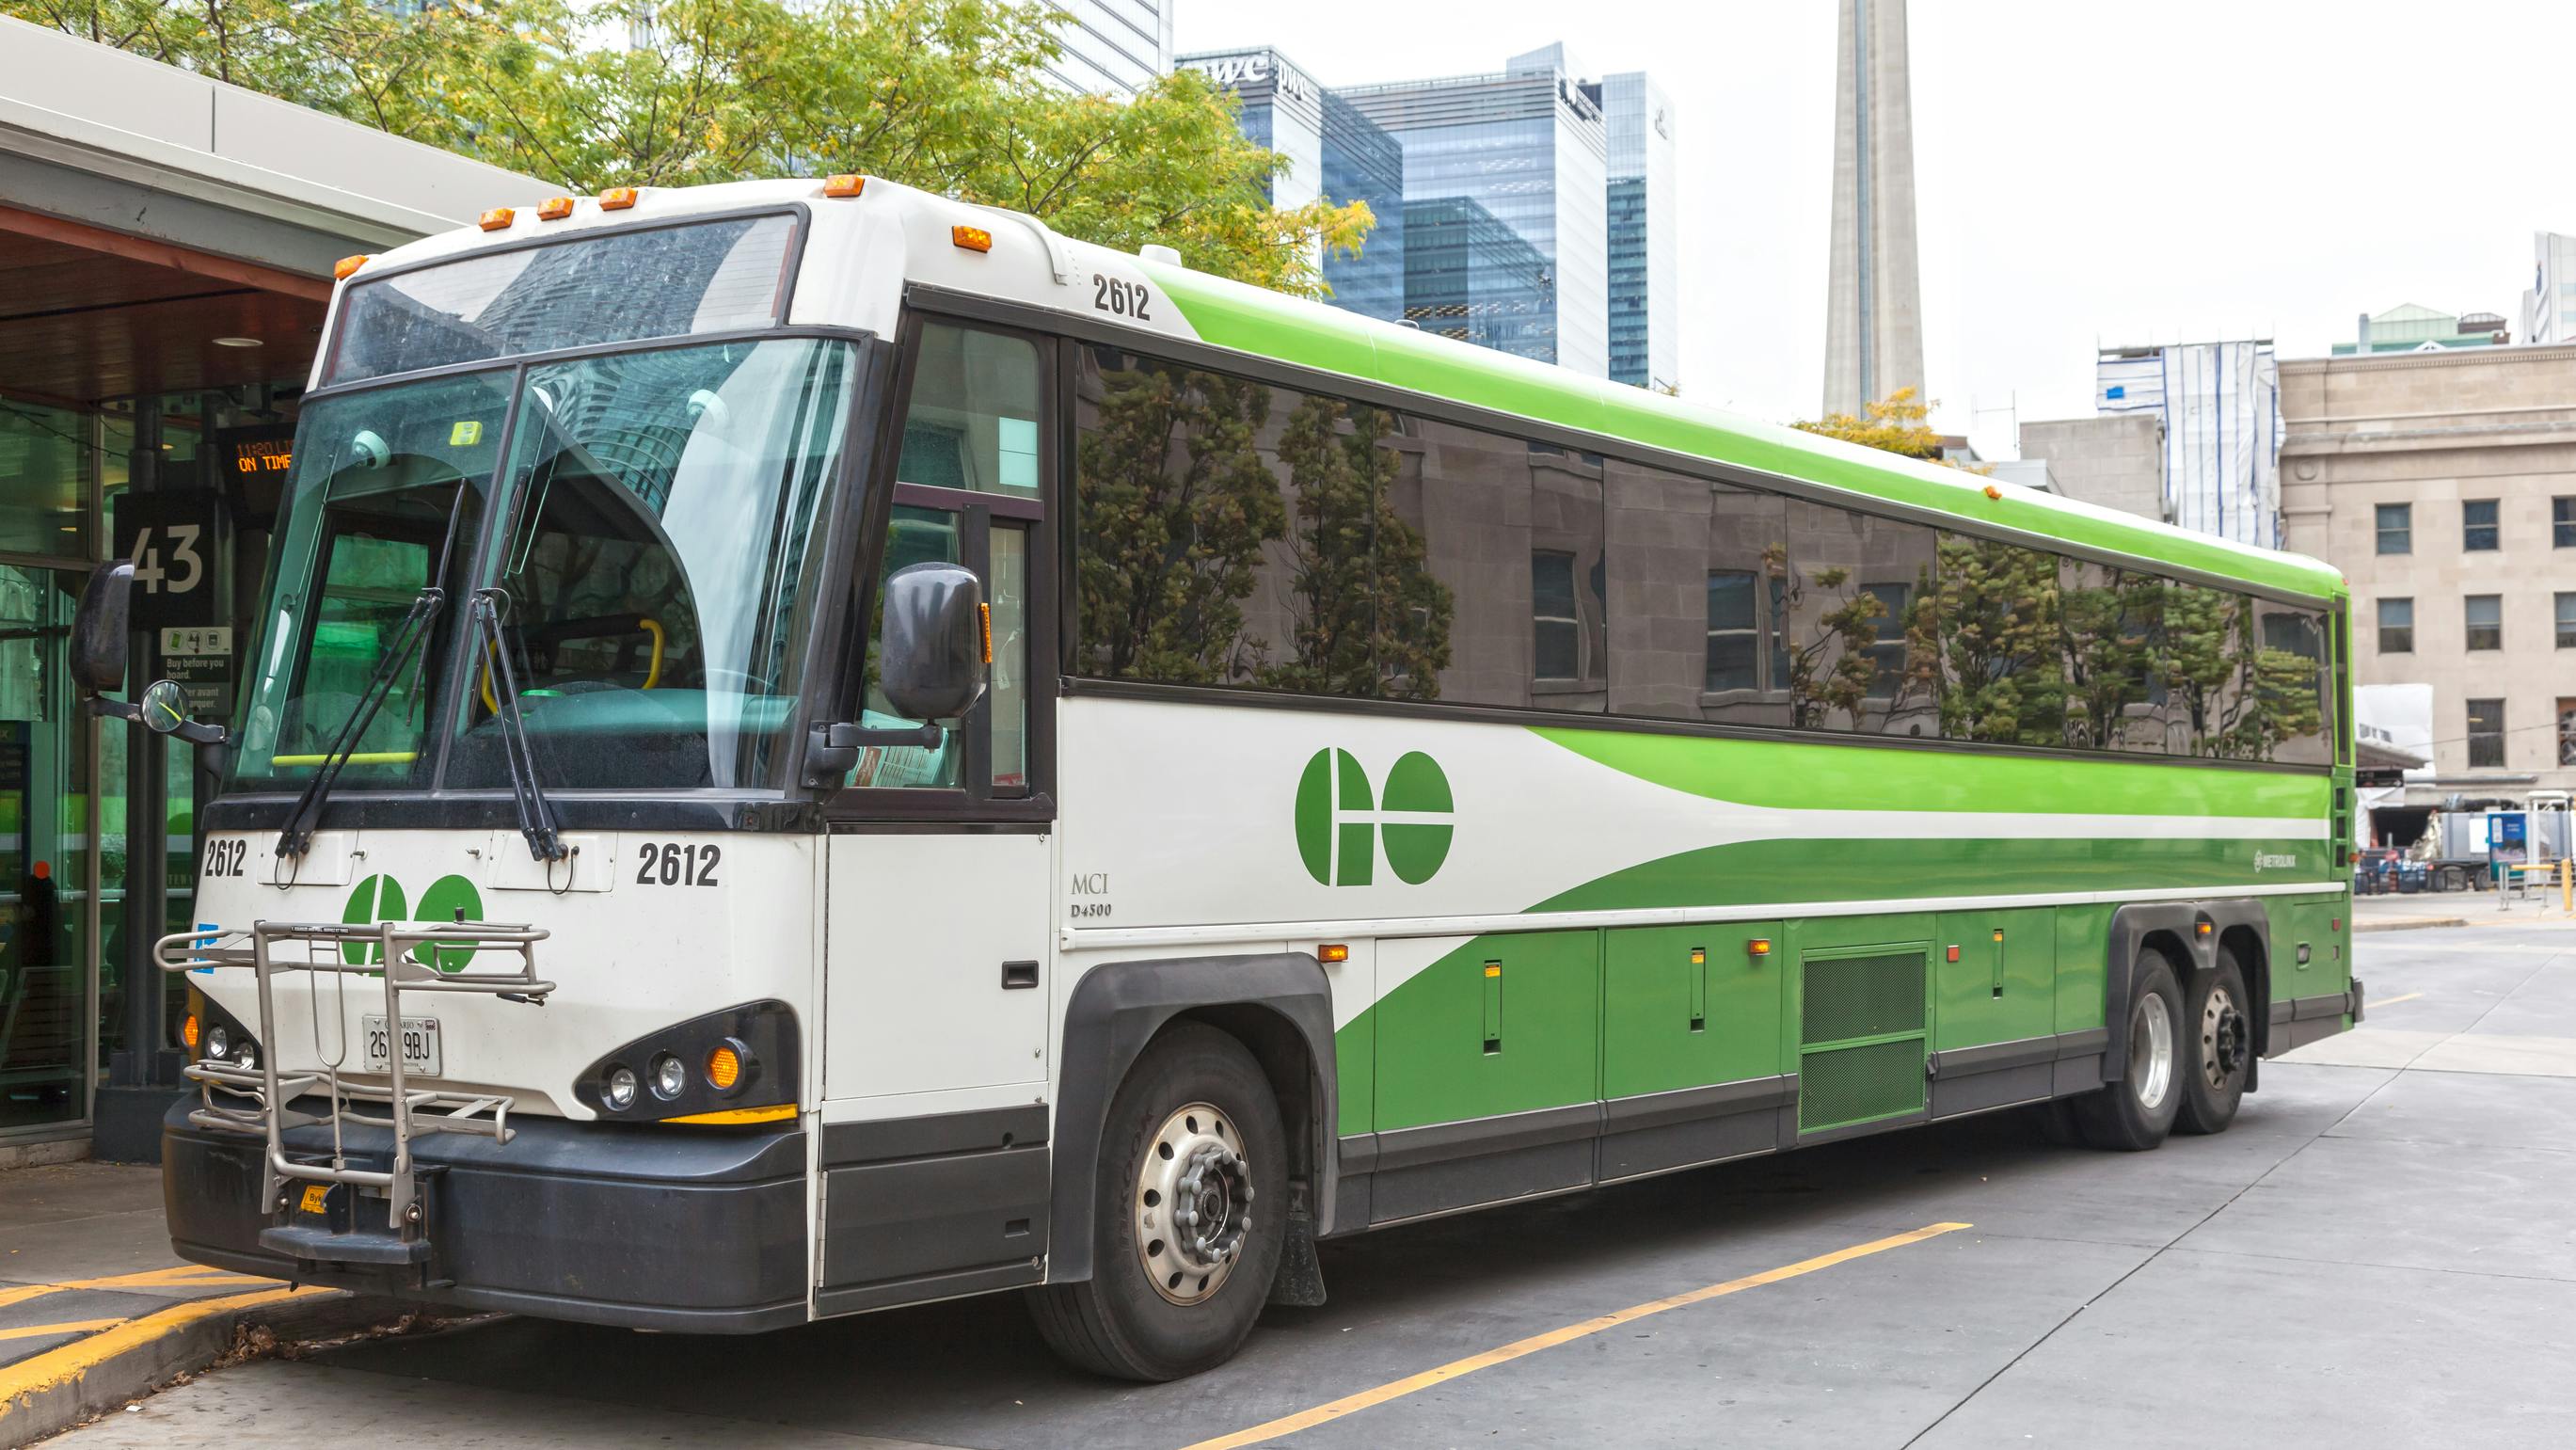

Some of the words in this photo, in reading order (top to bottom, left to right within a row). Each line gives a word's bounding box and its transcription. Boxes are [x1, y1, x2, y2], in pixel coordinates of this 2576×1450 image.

[1182, 56, 1268, 86] wc
[1093, 273, 1151, 322] 2612
[238, 456, 257, 472] ON
[132, 524, 202, 594] 43
[167, 659, 182, 670] Buy
[183, 658, 208, 668] before
[210, 660, 224, 670] you
[1295, 746, 1455, 886] GO
[205, 839, 246, 877] 2612
[636, 842, 722, 887] 2612
[1070, 872, 1109, 895] MCI
[1071, 903, 1112, 918] D4500
